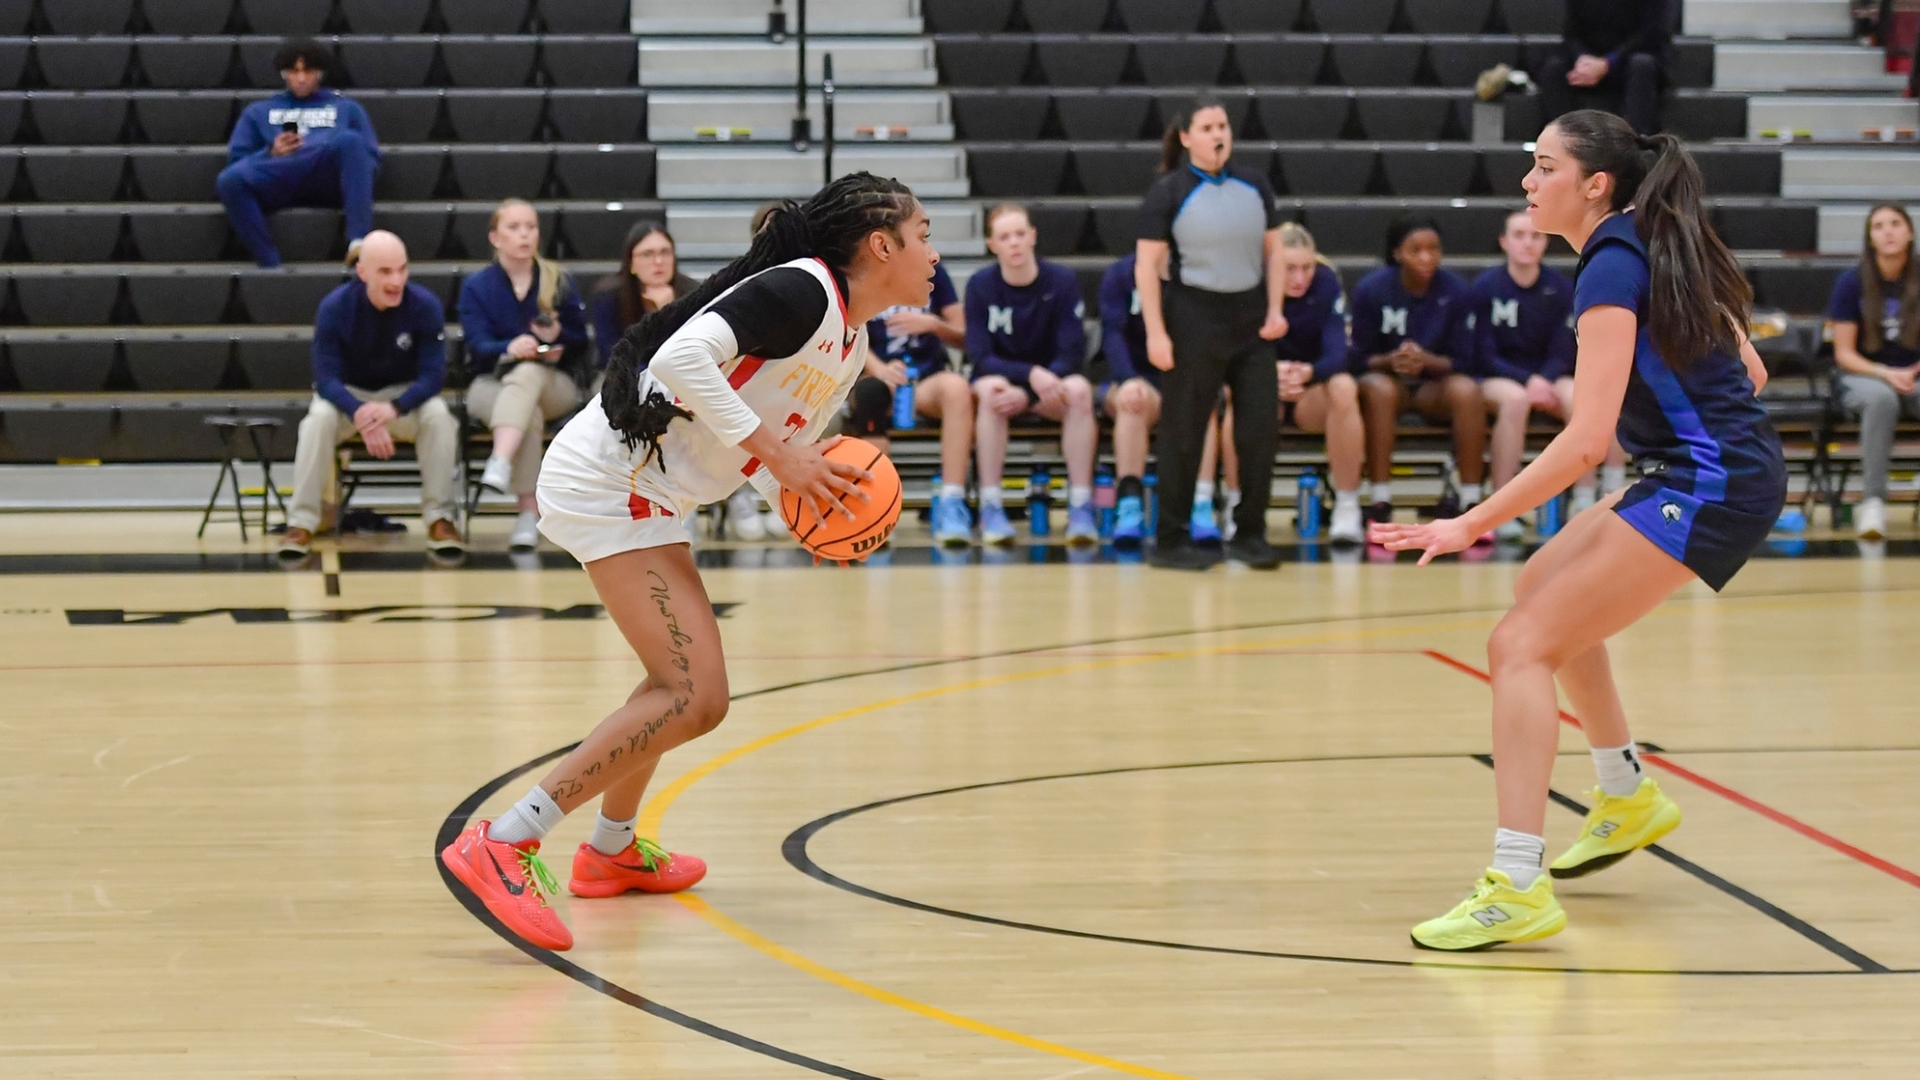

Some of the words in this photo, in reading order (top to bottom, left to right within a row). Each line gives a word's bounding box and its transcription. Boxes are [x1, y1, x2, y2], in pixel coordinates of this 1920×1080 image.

[988, 304, 1013, 335] M
[1381, 305, 1408, 336] M
[1492, 298, 1519, 328] M
[646, 570, 671, 618] Now
[667, 614, 693, 648] the
[626, 709, 674, 754] world
[1470, 905, 1511, 928] N
